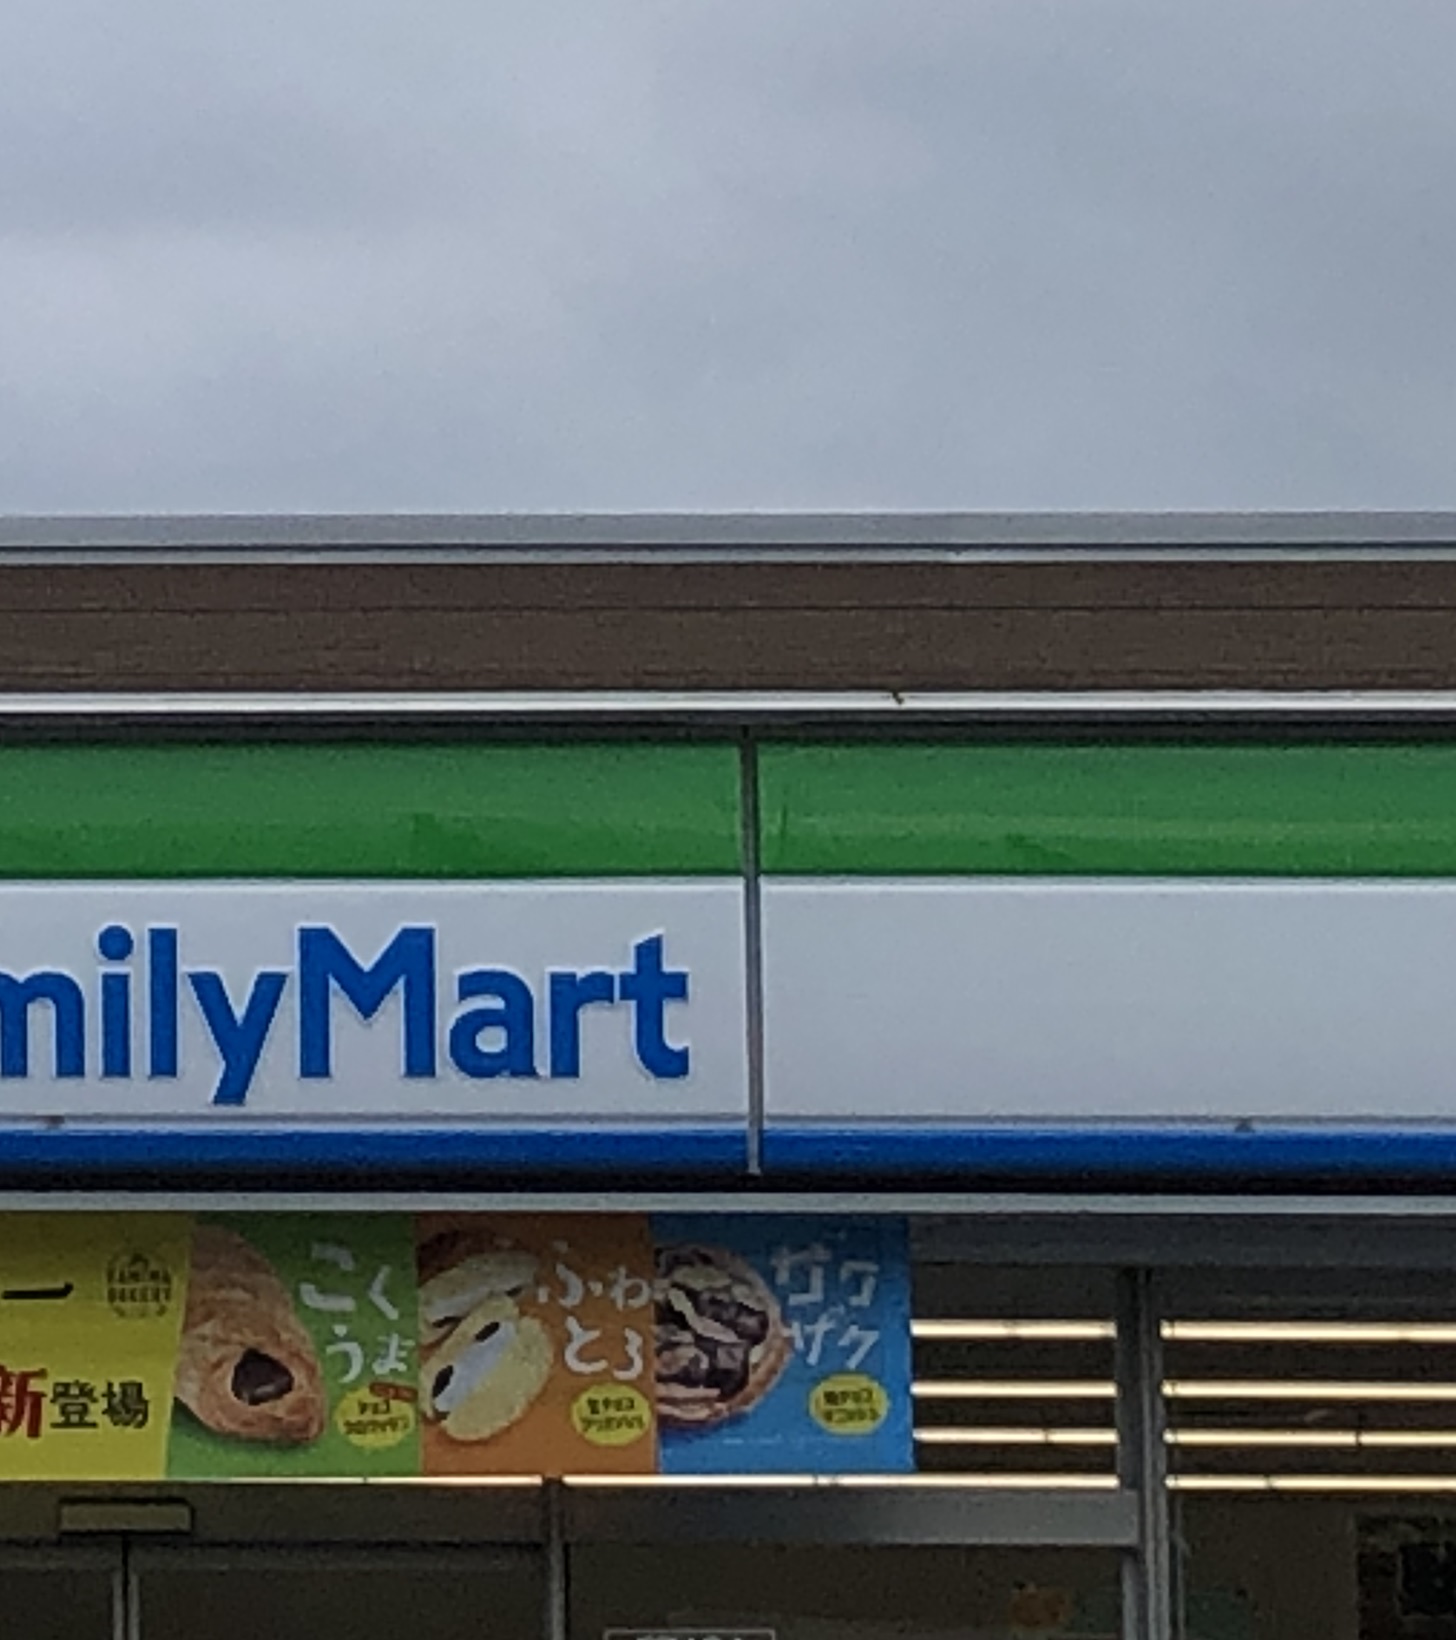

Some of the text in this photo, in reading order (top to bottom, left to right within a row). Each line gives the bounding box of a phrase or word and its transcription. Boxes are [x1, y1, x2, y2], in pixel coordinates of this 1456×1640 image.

[299, 1243, 399, 1320] こく
[538, 1240, 651, 1311] ふわ
[325, 1324, 416, 1384] うま
[564, 1315, 644, 1380] とろ
